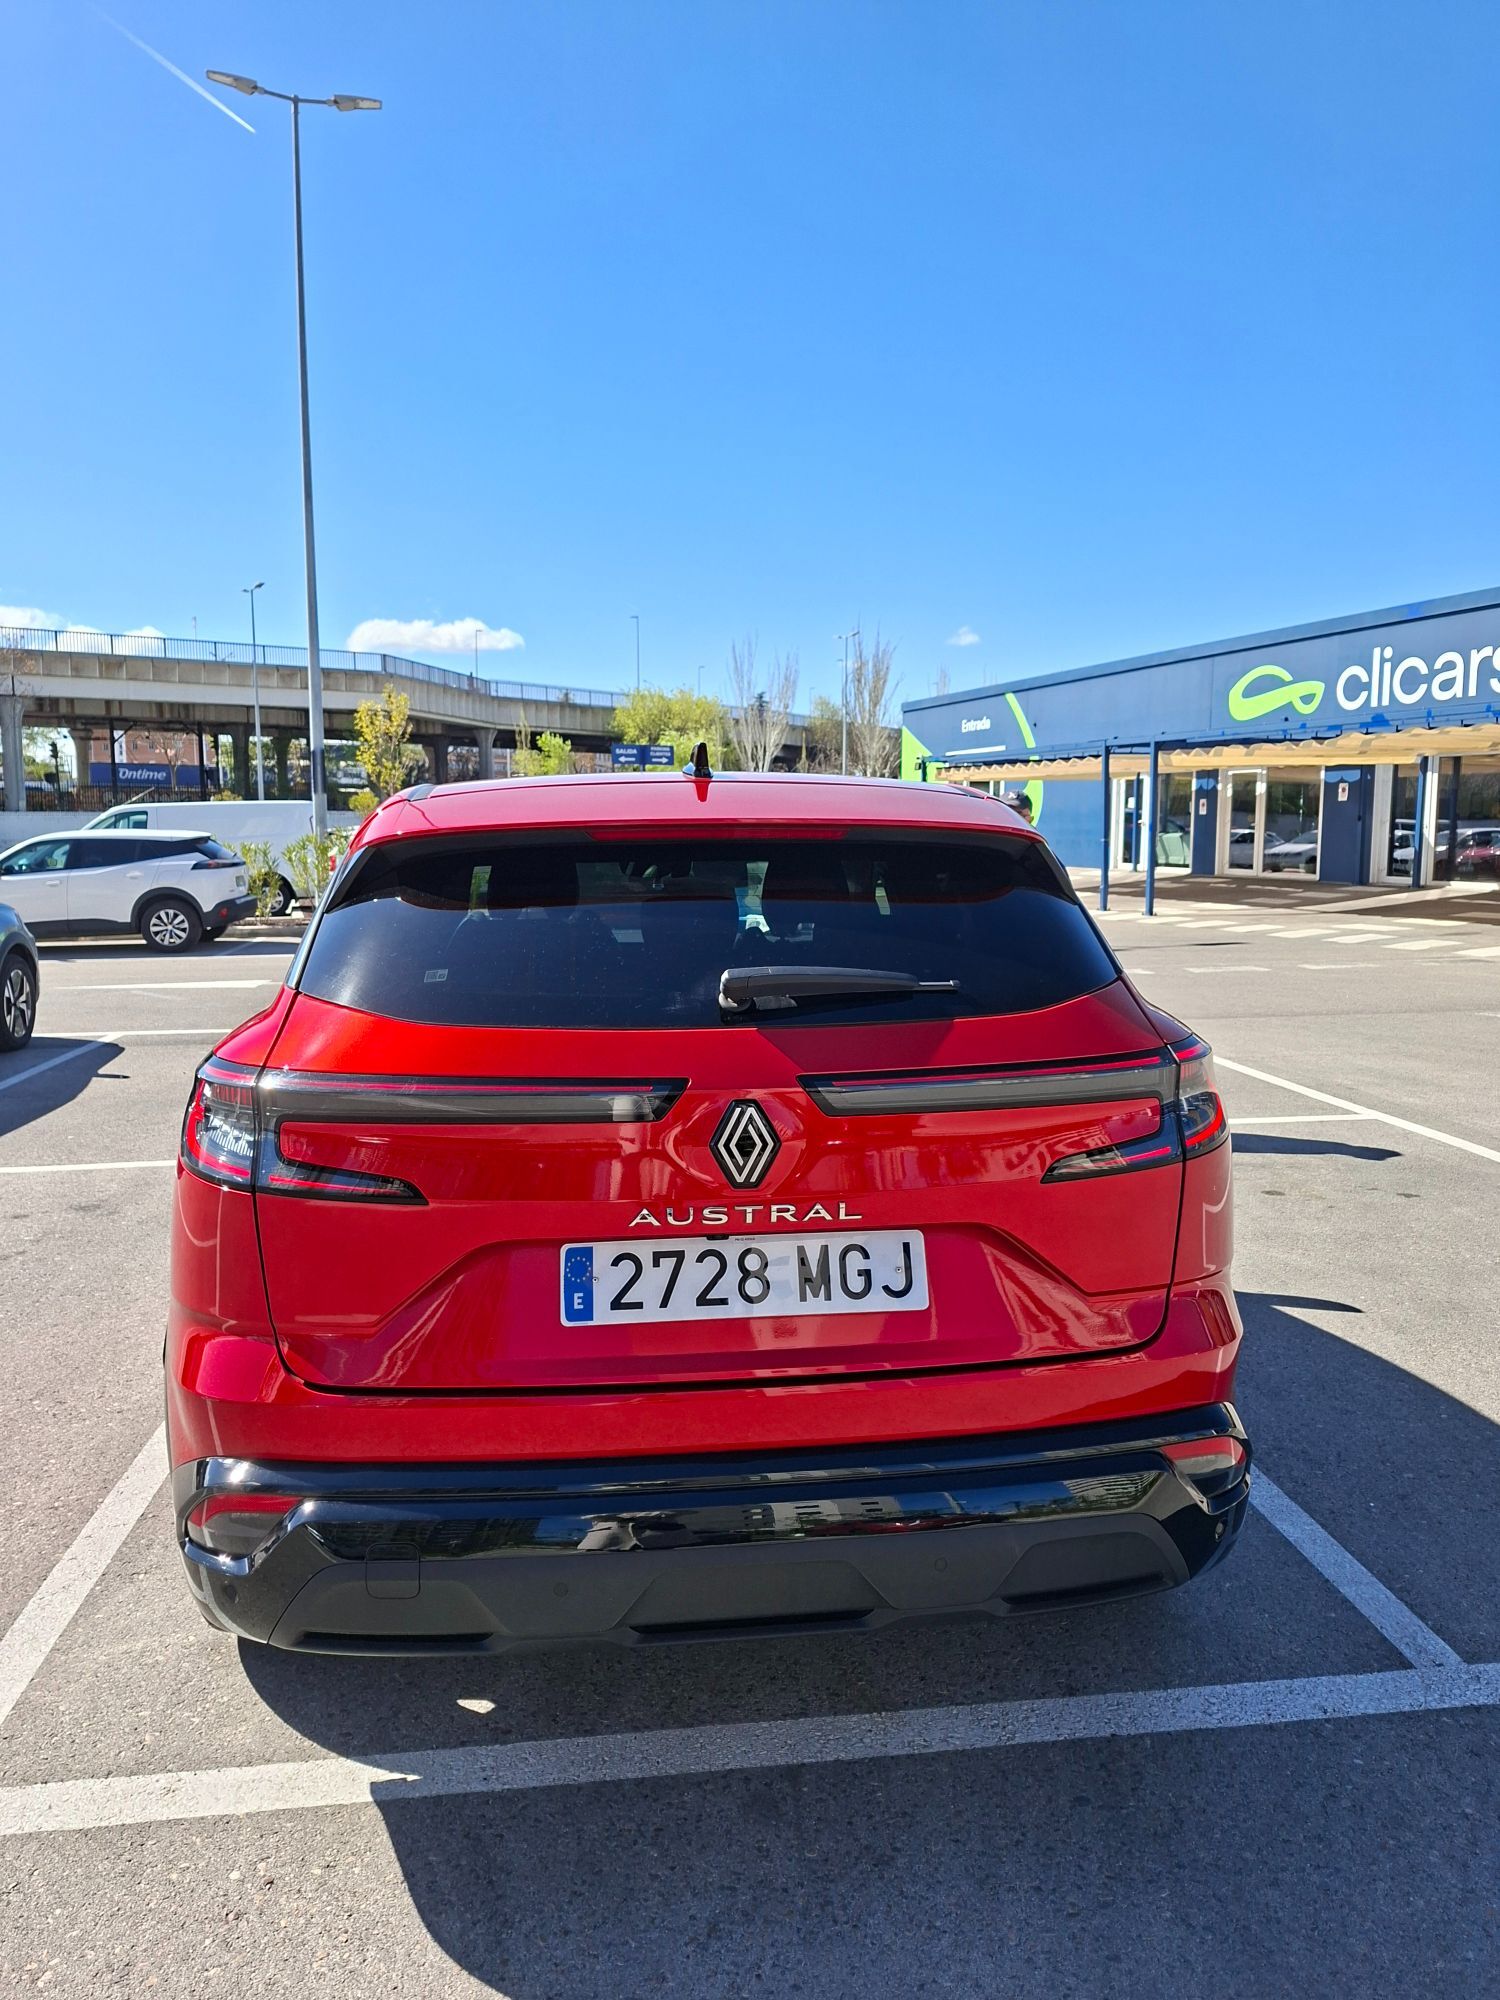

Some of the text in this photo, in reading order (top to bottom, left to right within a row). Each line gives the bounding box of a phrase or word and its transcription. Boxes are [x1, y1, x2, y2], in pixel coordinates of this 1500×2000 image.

[961, 715, 991, 733] Entrada
[118, 767, 167, 781] Ontime
[628, 1202, 863, 1227] AUSTRAL
[573, 1241, 914, 1311] E 2728 MGJ
